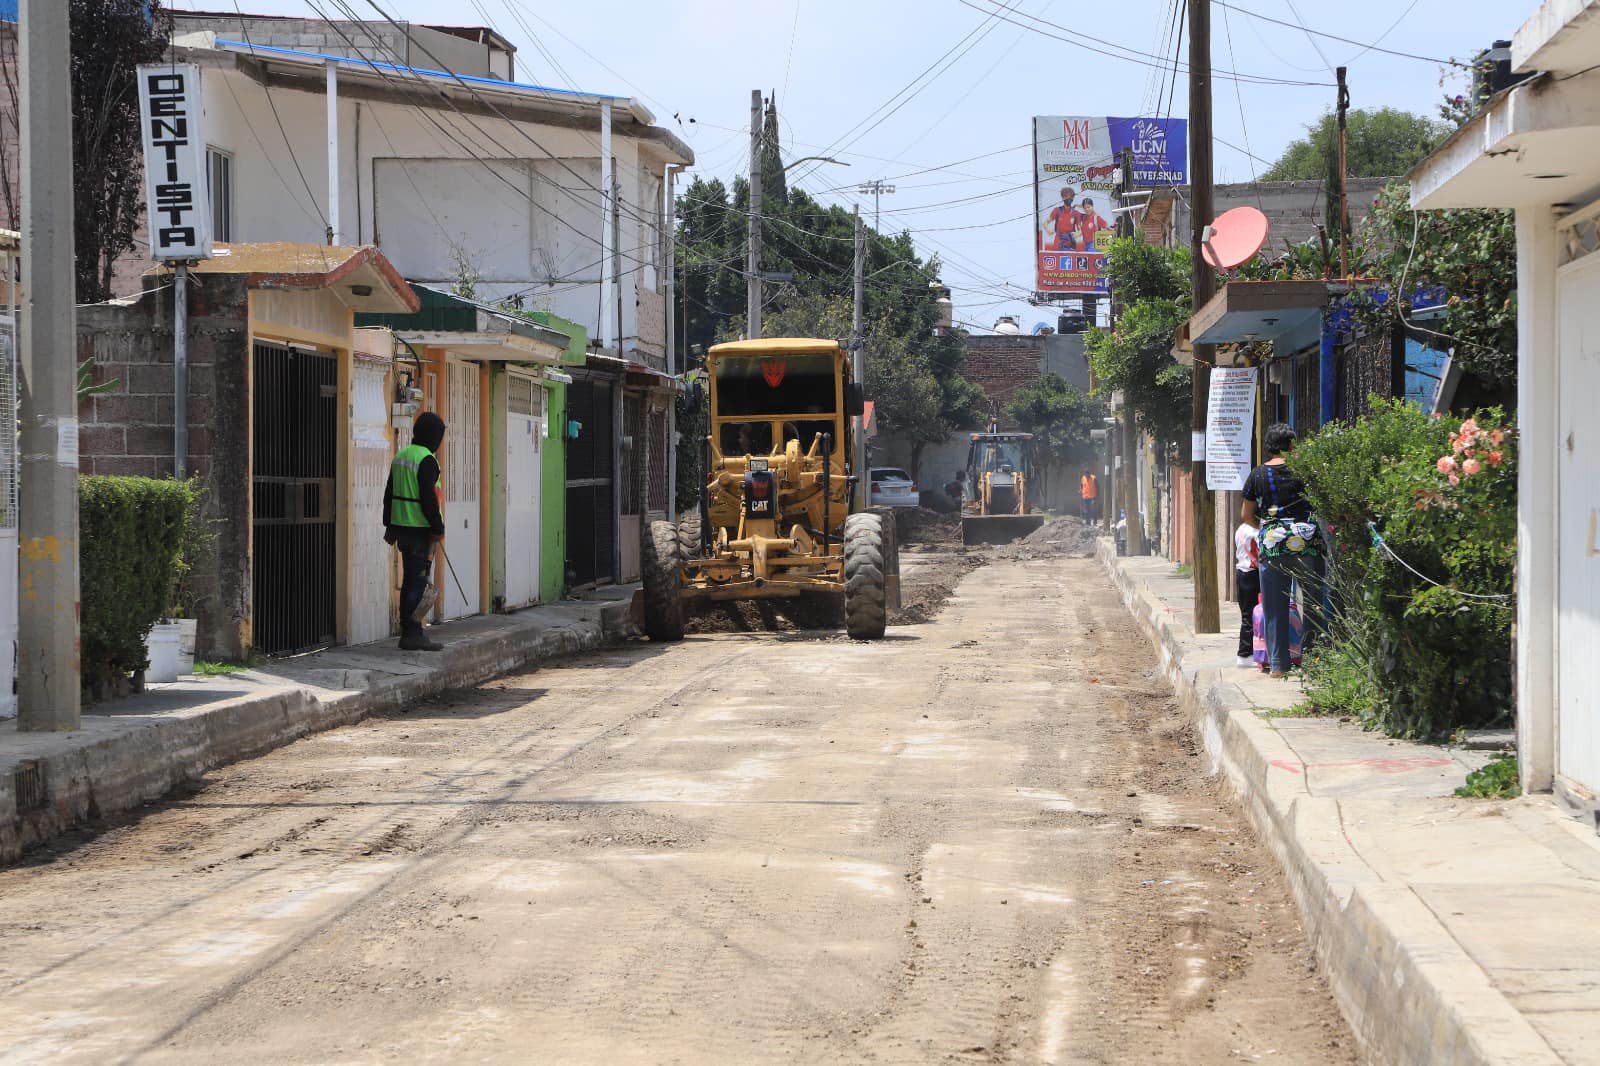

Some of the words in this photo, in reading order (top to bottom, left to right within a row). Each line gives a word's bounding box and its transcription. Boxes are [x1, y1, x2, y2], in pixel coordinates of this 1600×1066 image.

[1131, 139, 1167, 154] UCM
[148, 74, 196, 248] DENTISTA
[751, 500, 769, 512] CAT
